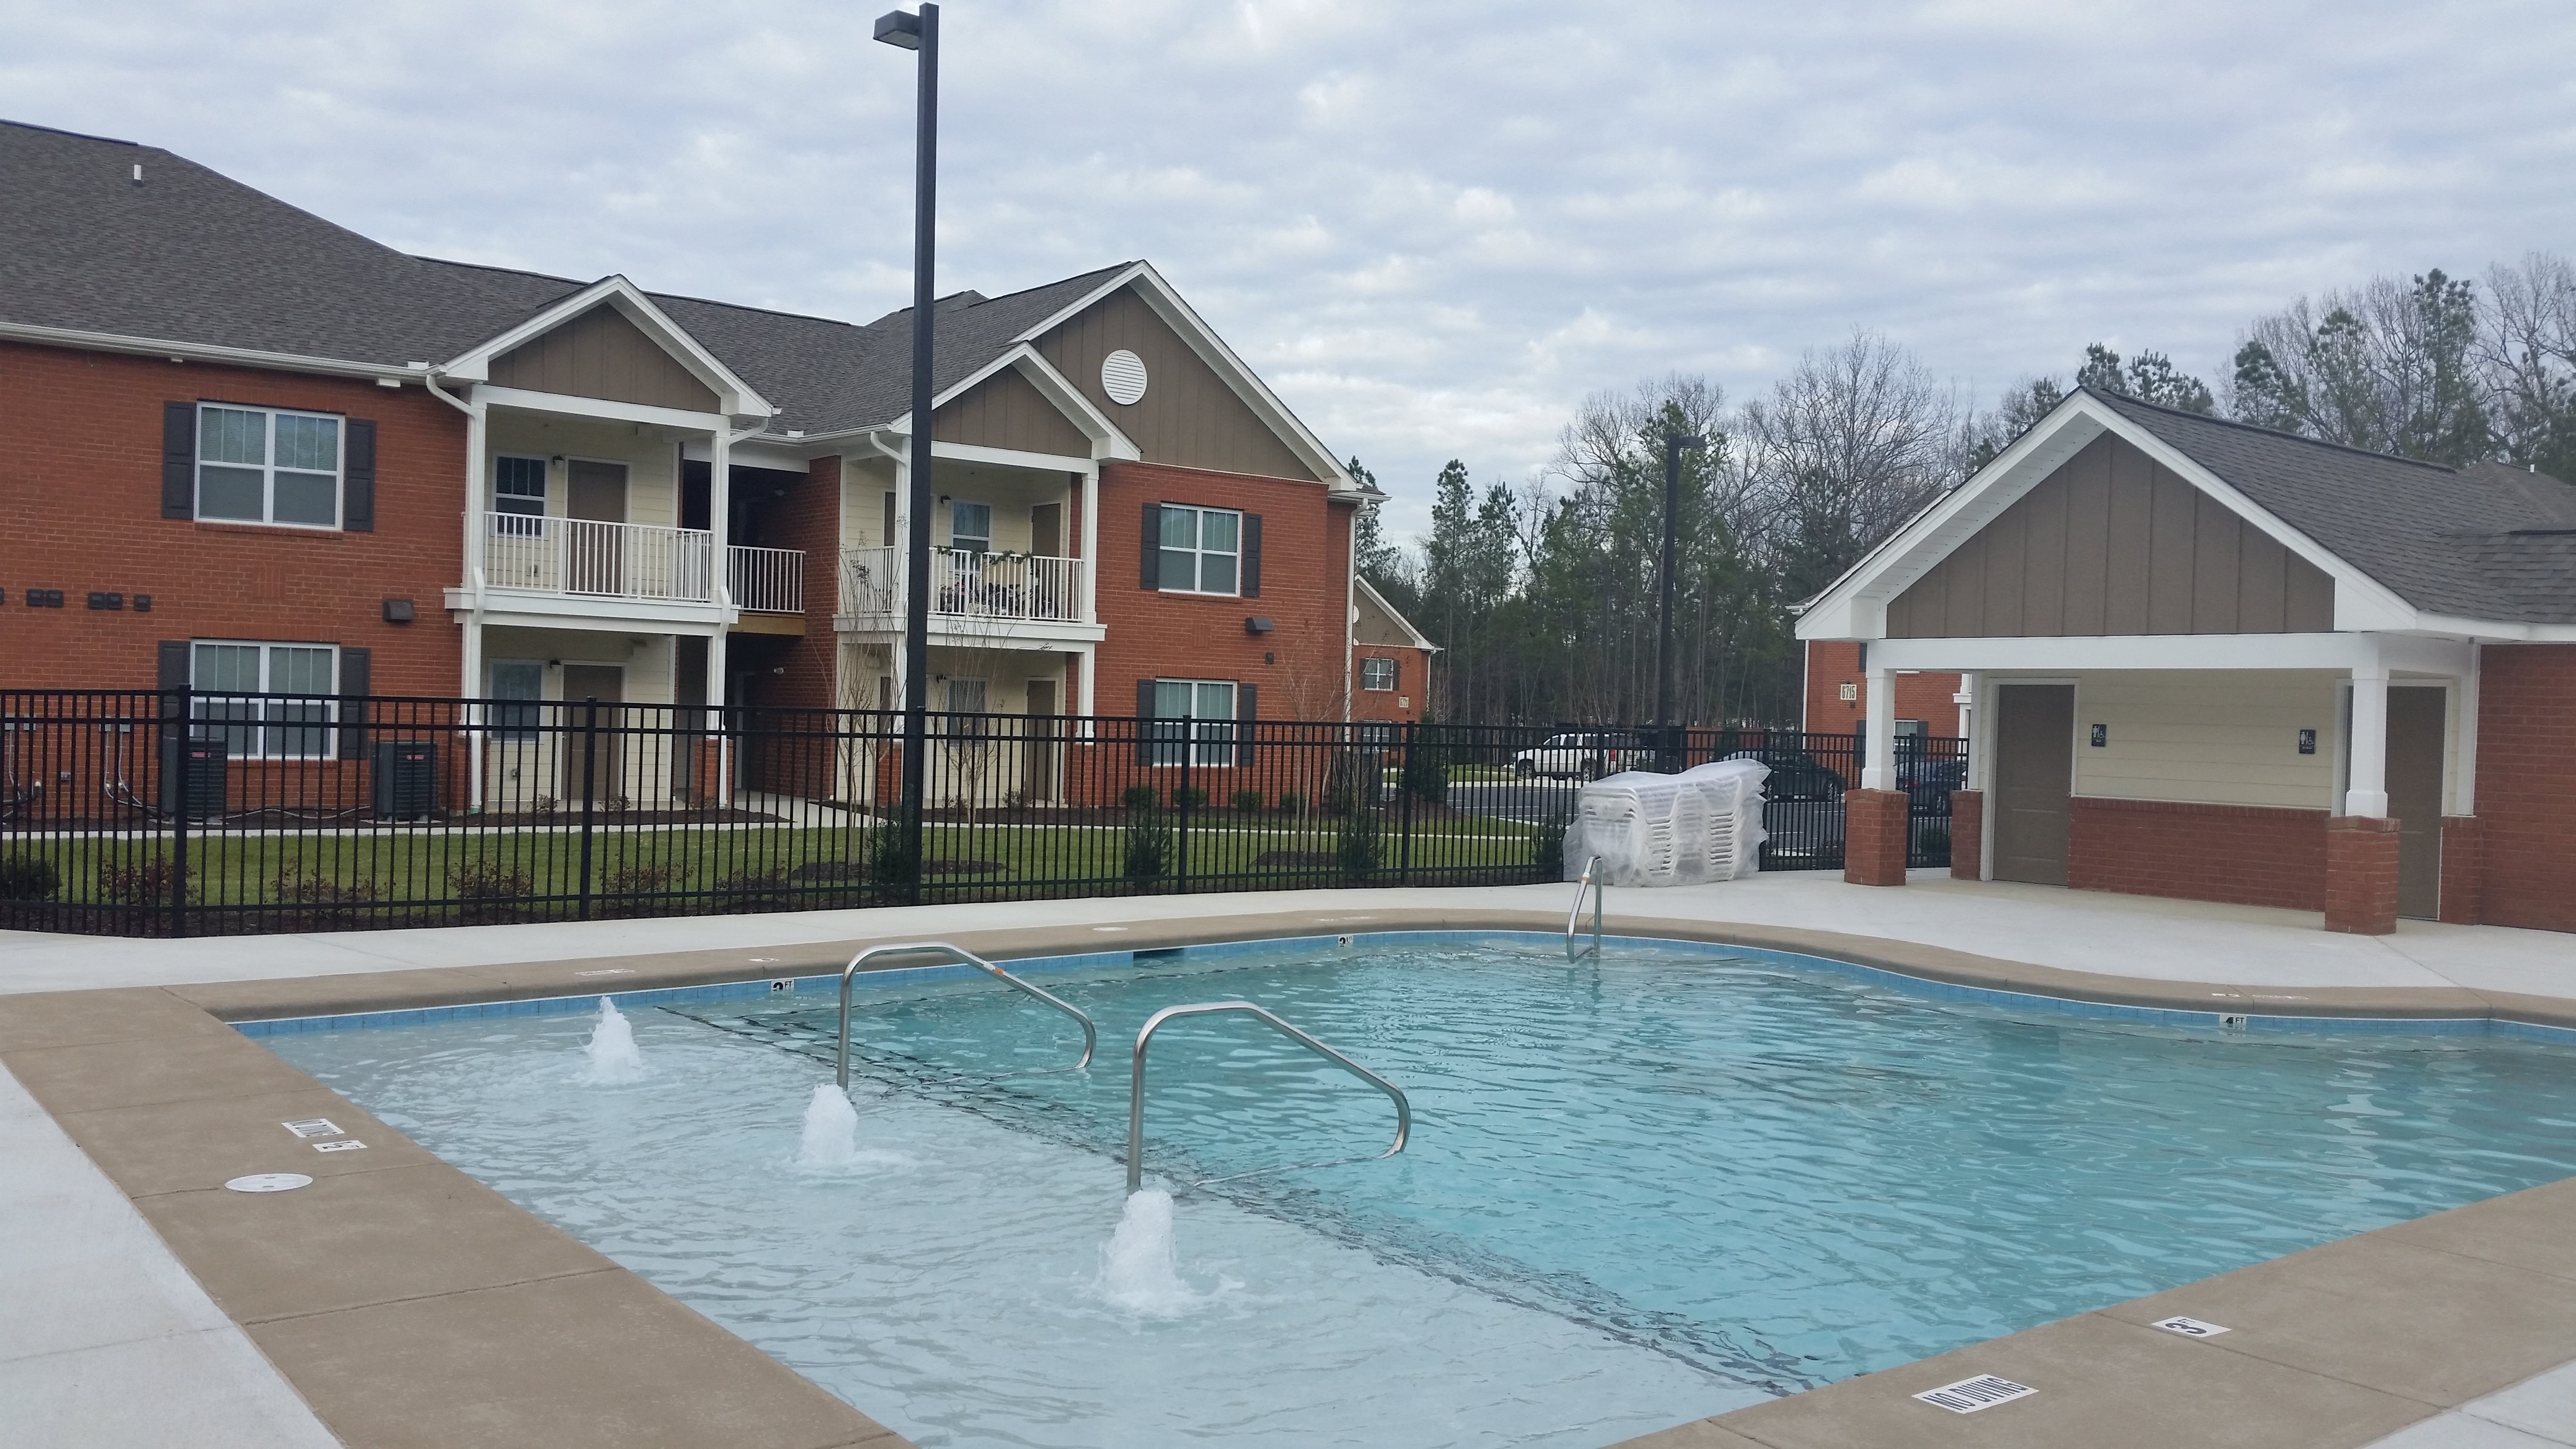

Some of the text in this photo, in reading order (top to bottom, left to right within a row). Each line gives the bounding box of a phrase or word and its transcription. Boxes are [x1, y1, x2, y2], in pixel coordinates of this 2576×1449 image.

[1842, 686, 1855, 698] 6715
[2165, 1322, 2207, 1334] 3
[1922, 1378, 2029, 1411] NO DIVING
